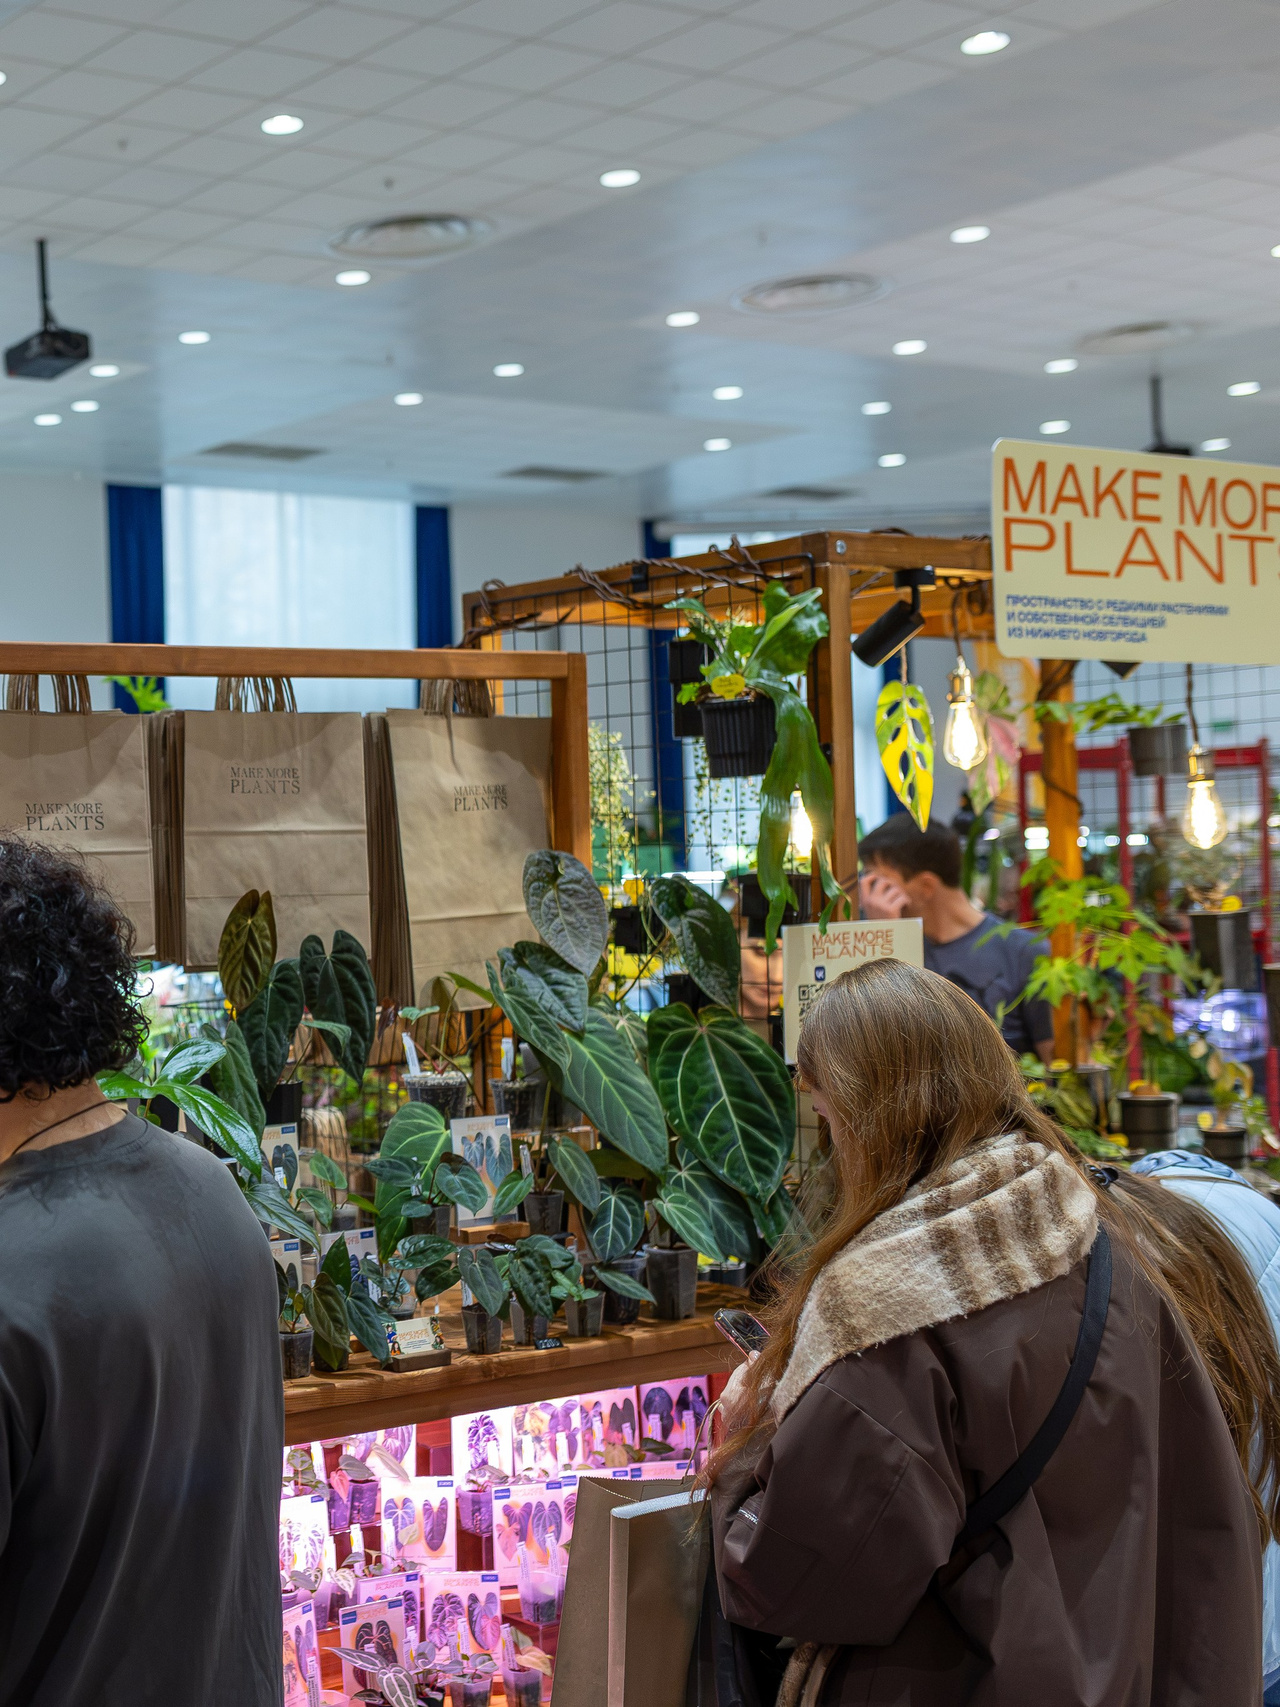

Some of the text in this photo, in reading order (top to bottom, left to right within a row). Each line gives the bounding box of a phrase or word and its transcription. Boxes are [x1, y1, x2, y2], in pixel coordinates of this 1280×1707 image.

[1003, 457, 1162, 524] MAKE
[1003, 517, 1280, 587] PLANT
[230, 766, 300, 779] MAKE MORE
[230, 779, 300, 794] PLANTS
[25, 802, 104, 814] MAKE MORE
[454, 796, 508, 811] PLANTS
[25, 815, 105, 831] PLANTS
[812, 928, 894, 947] MAKE MORE
[812, 944, 895, 960] PLANTS
